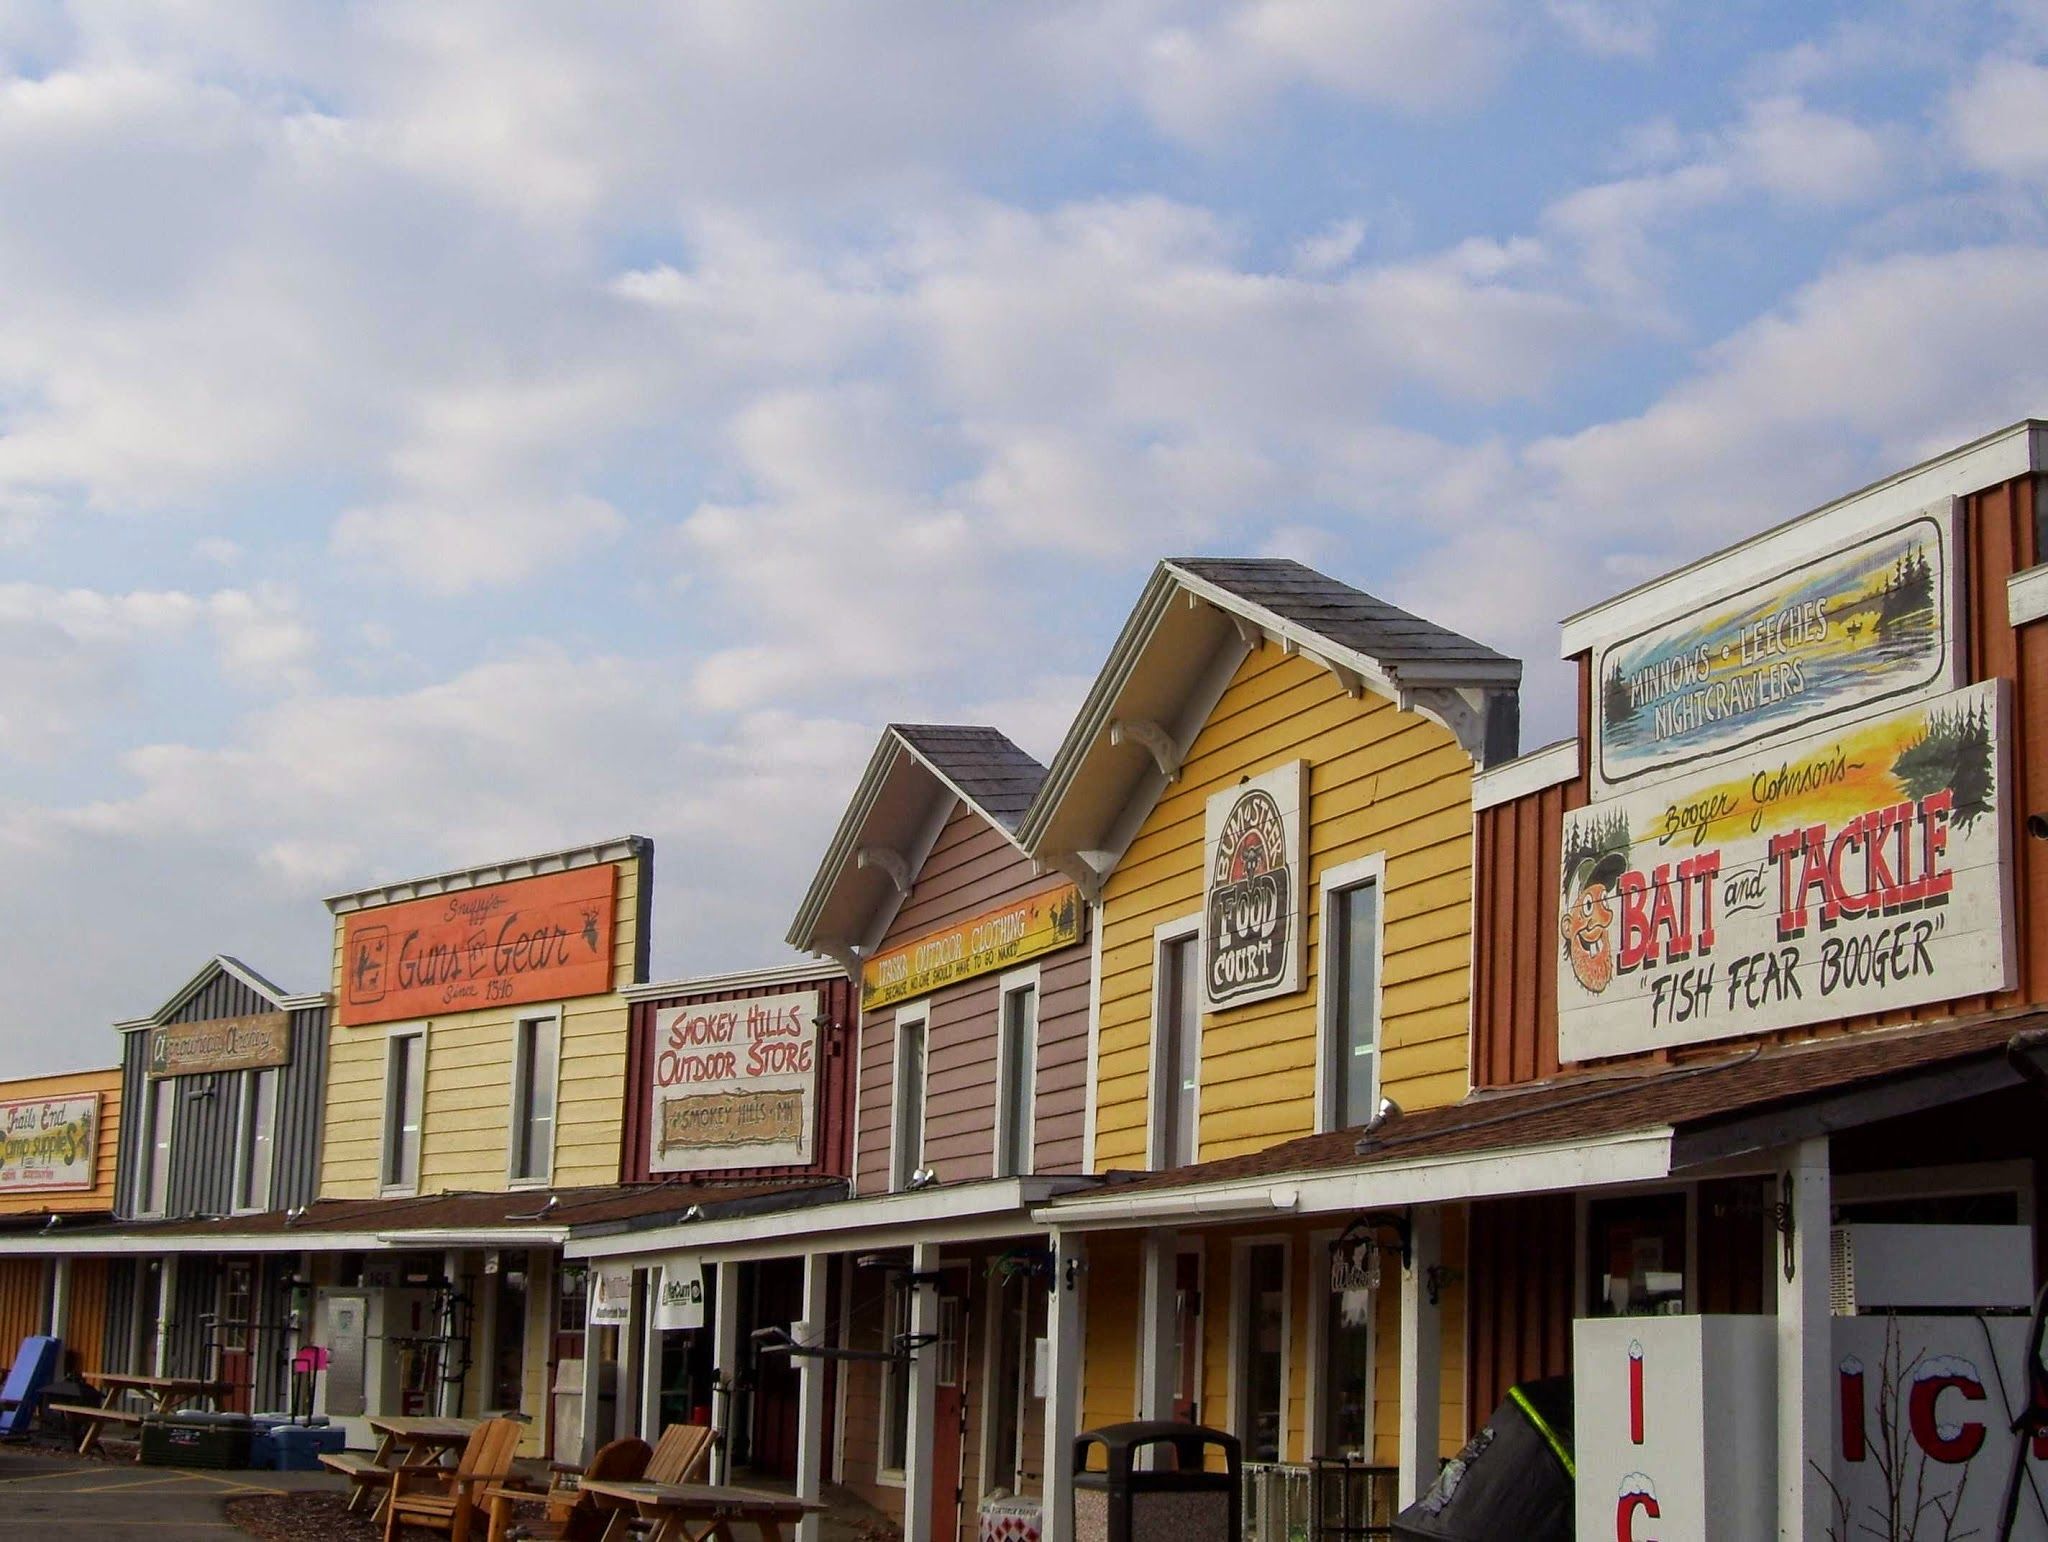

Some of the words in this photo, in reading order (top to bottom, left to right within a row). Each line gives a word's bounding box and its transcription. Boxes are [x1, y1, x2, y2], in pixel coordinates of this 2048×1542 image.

[1630, 641, 1711, 709] MINNOWS
[1737, 596, 1829, 668] LEECHES
[1652, 658, 1805, 742] NIGHTCRAWLERS
[1658, 791, 1739, 848] Booger
[1750, 744, 1848, 833] Johnson's
[1218, 876, 1278, 949] FOOD
[1616, 848, 1722, 976] BAIT
[1723, 862, 1767, 909] and
[1768, 787, 1954, 943] TACKLE
[398, 930, 462, 988] Guns
[495, 913, 568, 975] Gear
[915, 932, 963, 974] OUTDOOR
[971, 909, 1026, 954] CLOTHING
[932, 964, 953, 985] SHOULD
[974, 954, 982, 969] TO
[984, 951, 994, 966] GO
[1213, 939, 1273, 987] COURT
[1640, 962, 1716, 1029] "FISH
[1727, 946, 1803, 1012] FEAR
[1819, 911, 1946, 997] BOOGER"
[442, 982, 478, 1004] Since
[668, 1012, 738, 1050] SMOKEY
[746, 1003, 802, 1041] HILLS
[657, 1050, 737, 1088] OUTDOOR
[746, 1039, 813, 1077] STORE
[40, 1103, 67, 1131] End
[681, 1105, 732, 1130] SMOKEY
[737, 1102, 767, 1126] HILLS
